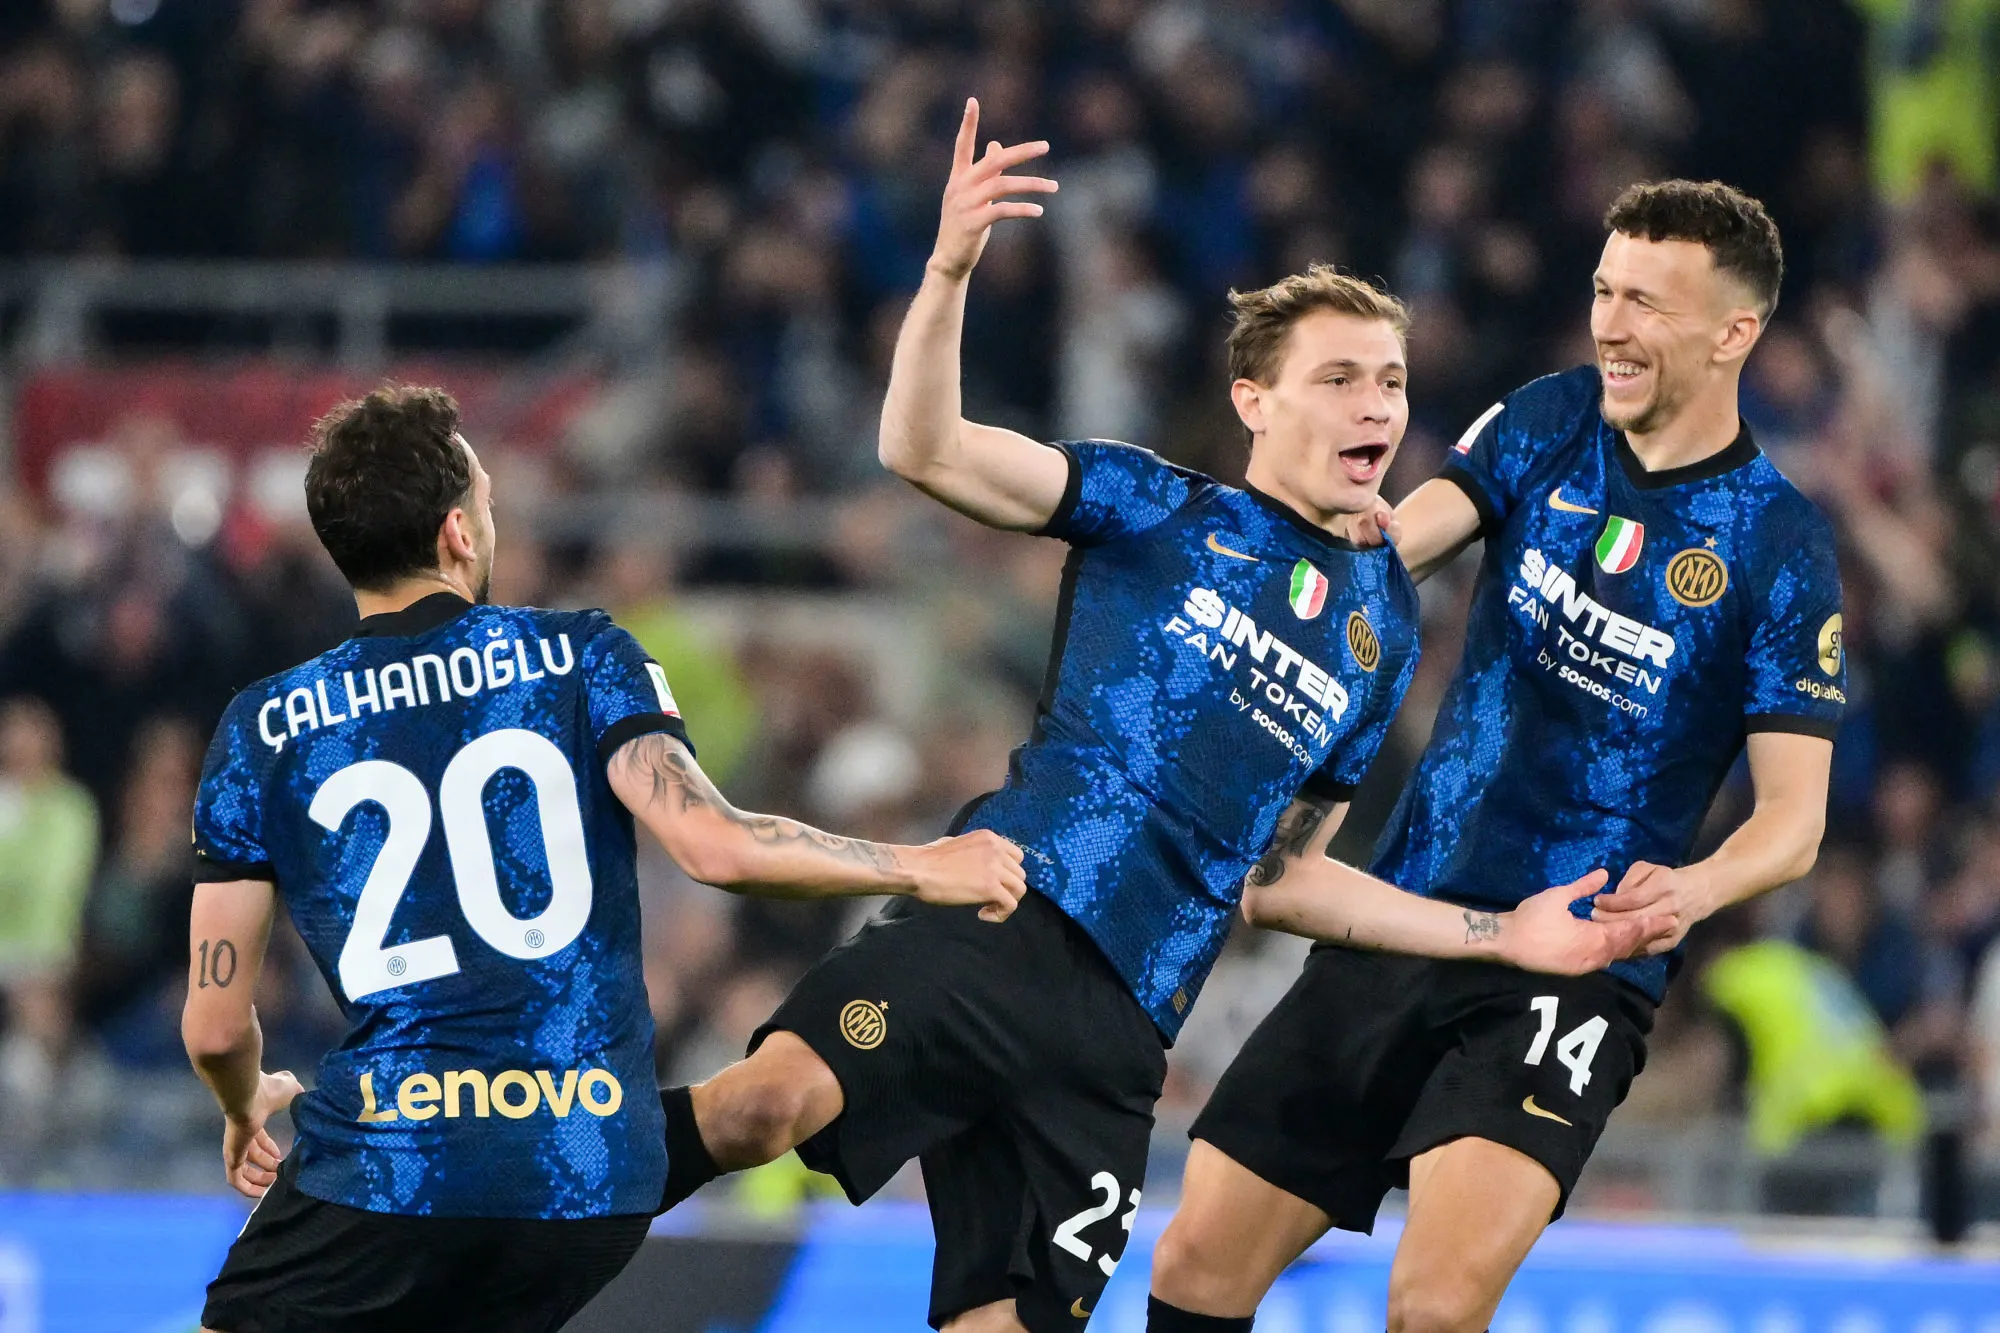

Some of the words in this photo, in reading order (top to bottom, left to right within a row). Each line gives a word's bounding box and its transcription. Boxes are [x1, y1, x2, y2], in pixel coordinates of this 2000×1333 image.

[257, 627, 574, 754] ÇALHANOĞLU
[1163, 616, 1238, 671] FAN
[1250, 667, 1333, 749] TOKEN
[1507, 585, 1550, 630] FAN
[1557, 624, 1662, 695] TOKEN
[1536, 647, 1558, 671] by
[1558, 665, 1648, 719] socios.com
[1228, 687, 1252, 712] by
[1251, 708, 1313, 771] socios.com
[308, 728, 593, 1004] 20
[198, 939, 237, 988] 10
[356, 1068, 623, 1123] Lenovo
[1523, 995, 1609, 1097] 14
